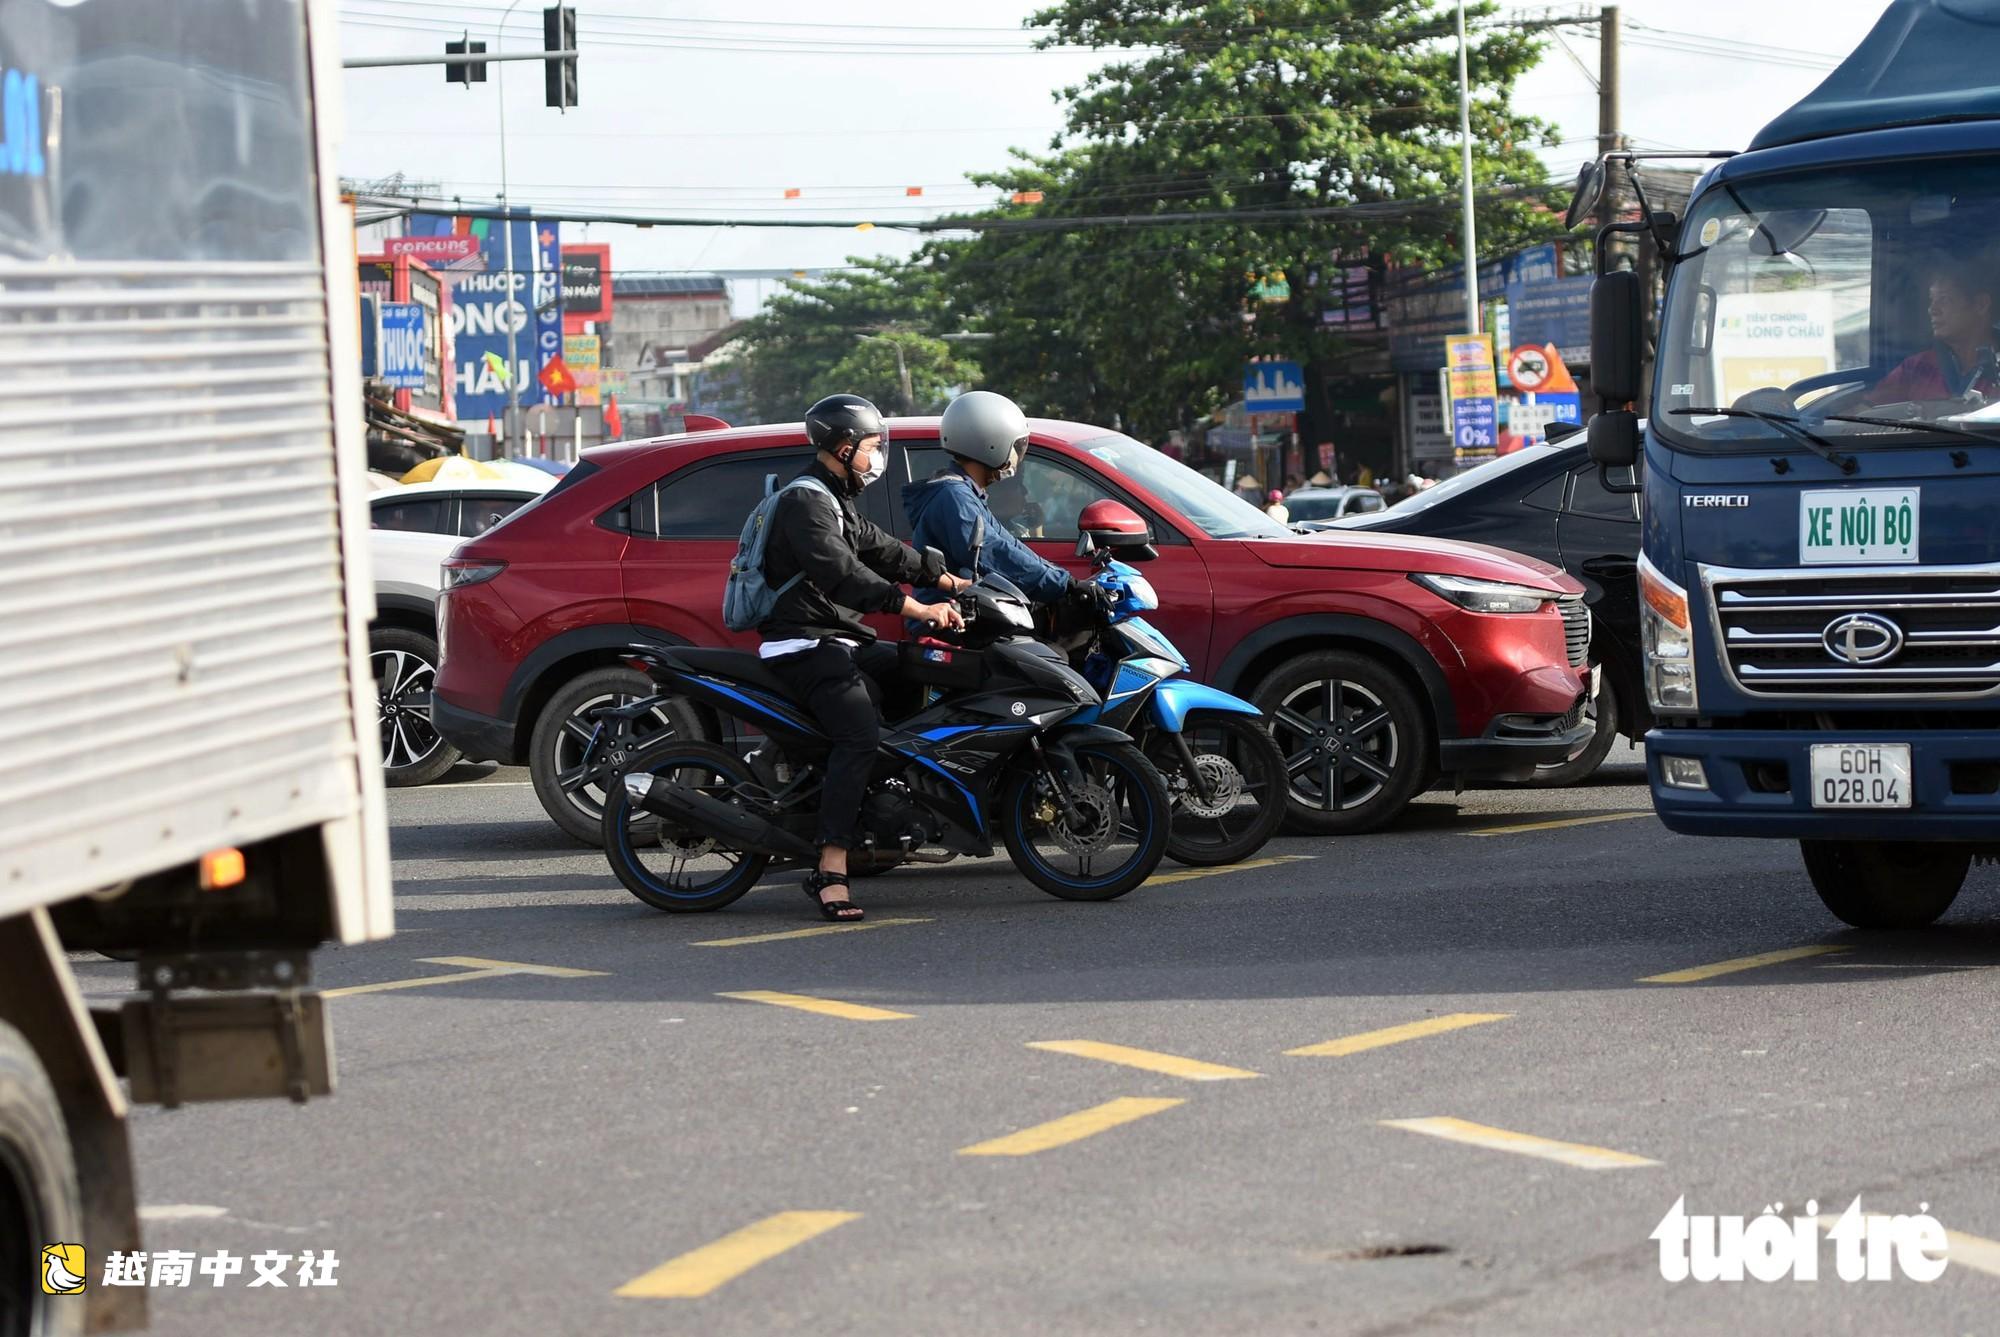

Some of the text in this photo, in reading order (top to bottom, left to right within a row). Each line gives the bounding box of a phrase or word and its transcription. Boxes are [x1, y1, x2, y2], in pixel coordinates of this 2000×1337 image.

[1747, 322, 1824, 338] LONG CHÂU
[1460, 426, 1490, 445] 0%
[1683, 495, 1749, 507] TERACO
[1808, 496, 1912, 555] XE NỘI BỘ
[937, 758, 977, 775] 150
[1840, 750, 1881, 774] 60H
[1824, 777, 1899, 804] 028.04
